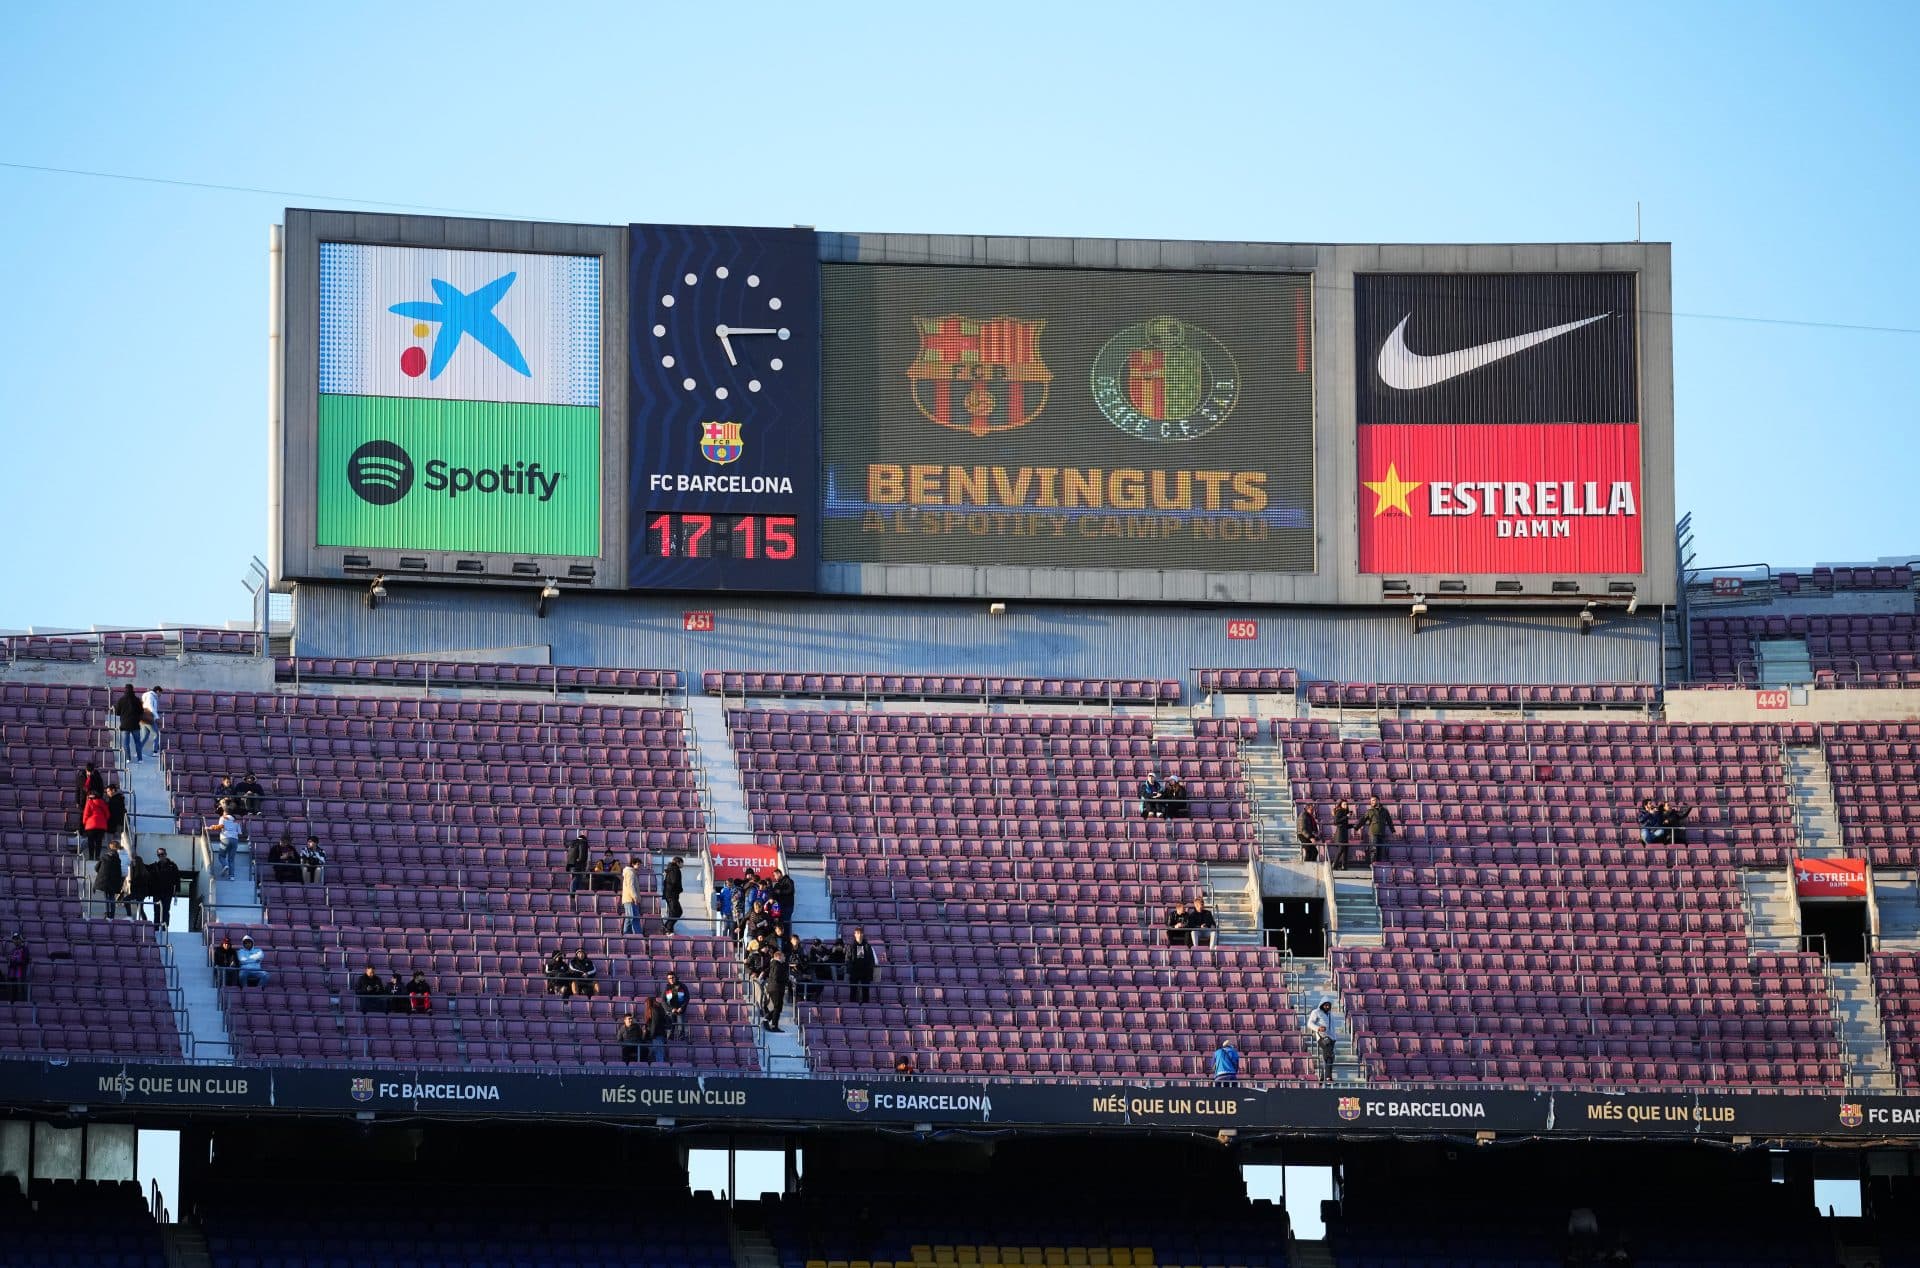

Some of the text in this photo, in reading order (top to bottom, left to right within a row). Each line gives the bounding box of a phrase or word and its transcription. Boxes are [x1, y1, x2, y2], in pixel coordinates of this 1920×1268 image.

[424, 459, 560, 501] Spotify
[650, 474, 793, 493] FC BARCELONA
[867, 464, 1268, 511] BENVINGUTS
[1429, 481, 1637, 516] ESTRELLA
[863, 511, 886, 534] A
[1079, 515, 1182, 538] CAMP
[1193, 517, 1270, 540] NOU
[1496, 519, 1570, 537] DAMM
[688, 614, 710, 629] 451
[1229, 623, 1256, 637] 450
[107, 660, 135, 675] 452
[1758, 693, 1786, 708] 449
[727, 857, 777, 868] ESTRELLA
[1813, 872, 1865, 882] ESTRELLA
[138, 1077, 173, 1095] QUE
[177, 1078, 201, 1093] UN
[205, 1079, 249, 1094] CLUB
[379, 1083, 500, 1100] FC BARCELONA
[601, 1084, 746, 1106] MÉS QUE UN CLUB
[874, 1094, 992, 1111] FC BARCELONA
[1092, 1094, 1237, 1116] MÉS QUE UN CLUB
[1366, 1102, 1486, 1118] FC BARCELONA
[1587, 1101, 1735, 1123] MÉS QUE UN CLUB
[1868, 1108, 1889, 1123] FC
